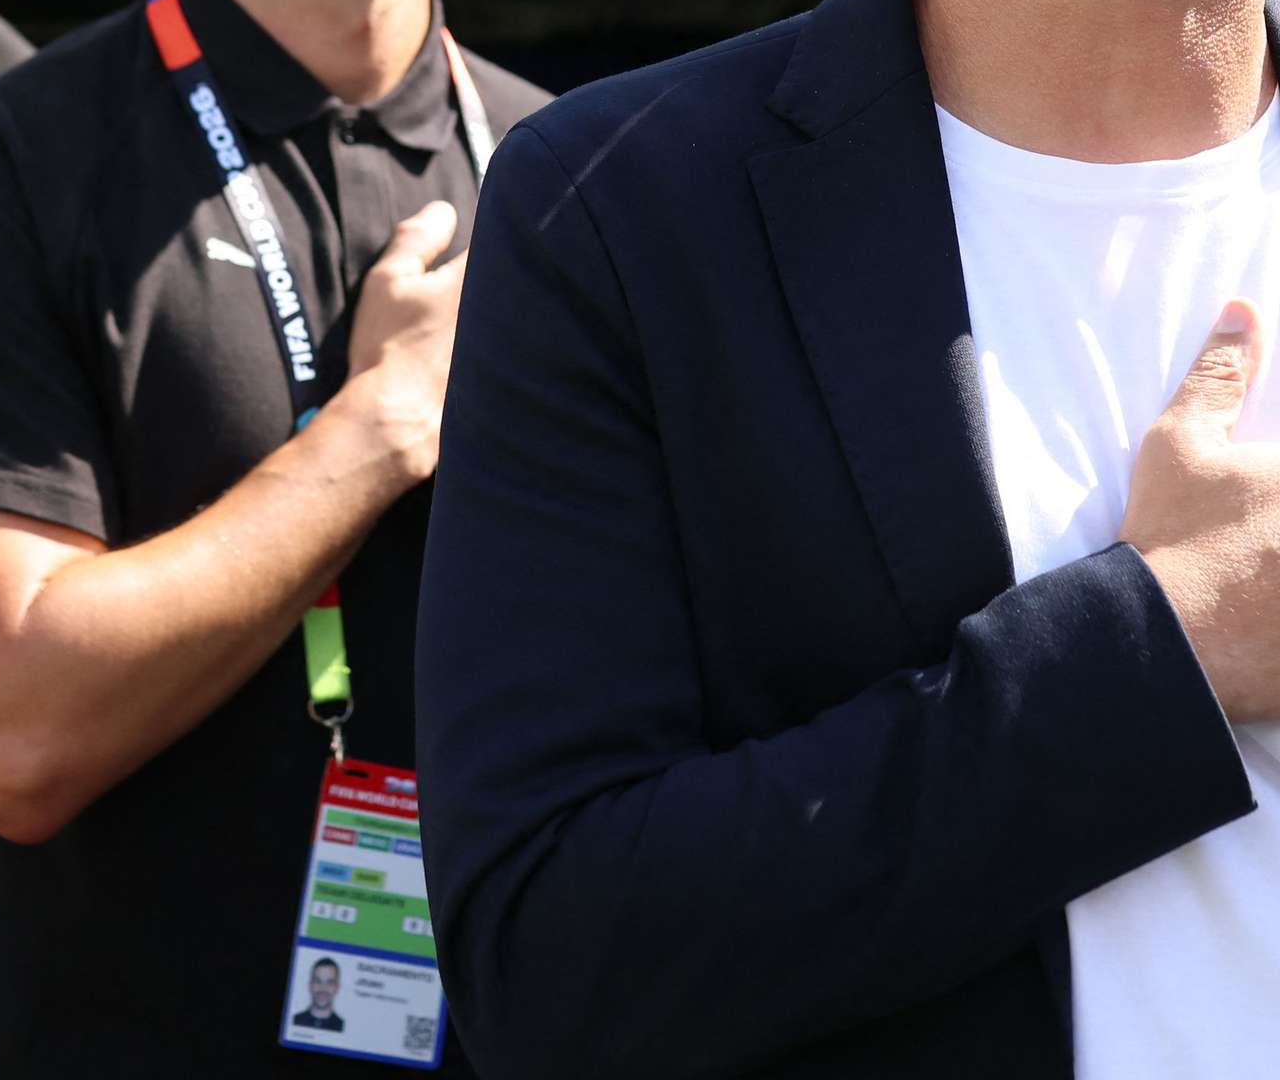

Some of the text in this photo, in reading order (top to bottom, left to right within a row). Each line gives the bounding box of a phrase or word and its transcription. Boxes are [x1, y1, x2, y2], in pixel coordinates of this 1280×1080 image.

[189, 83, 316, 382] FIFA WORLD CUP 2026
